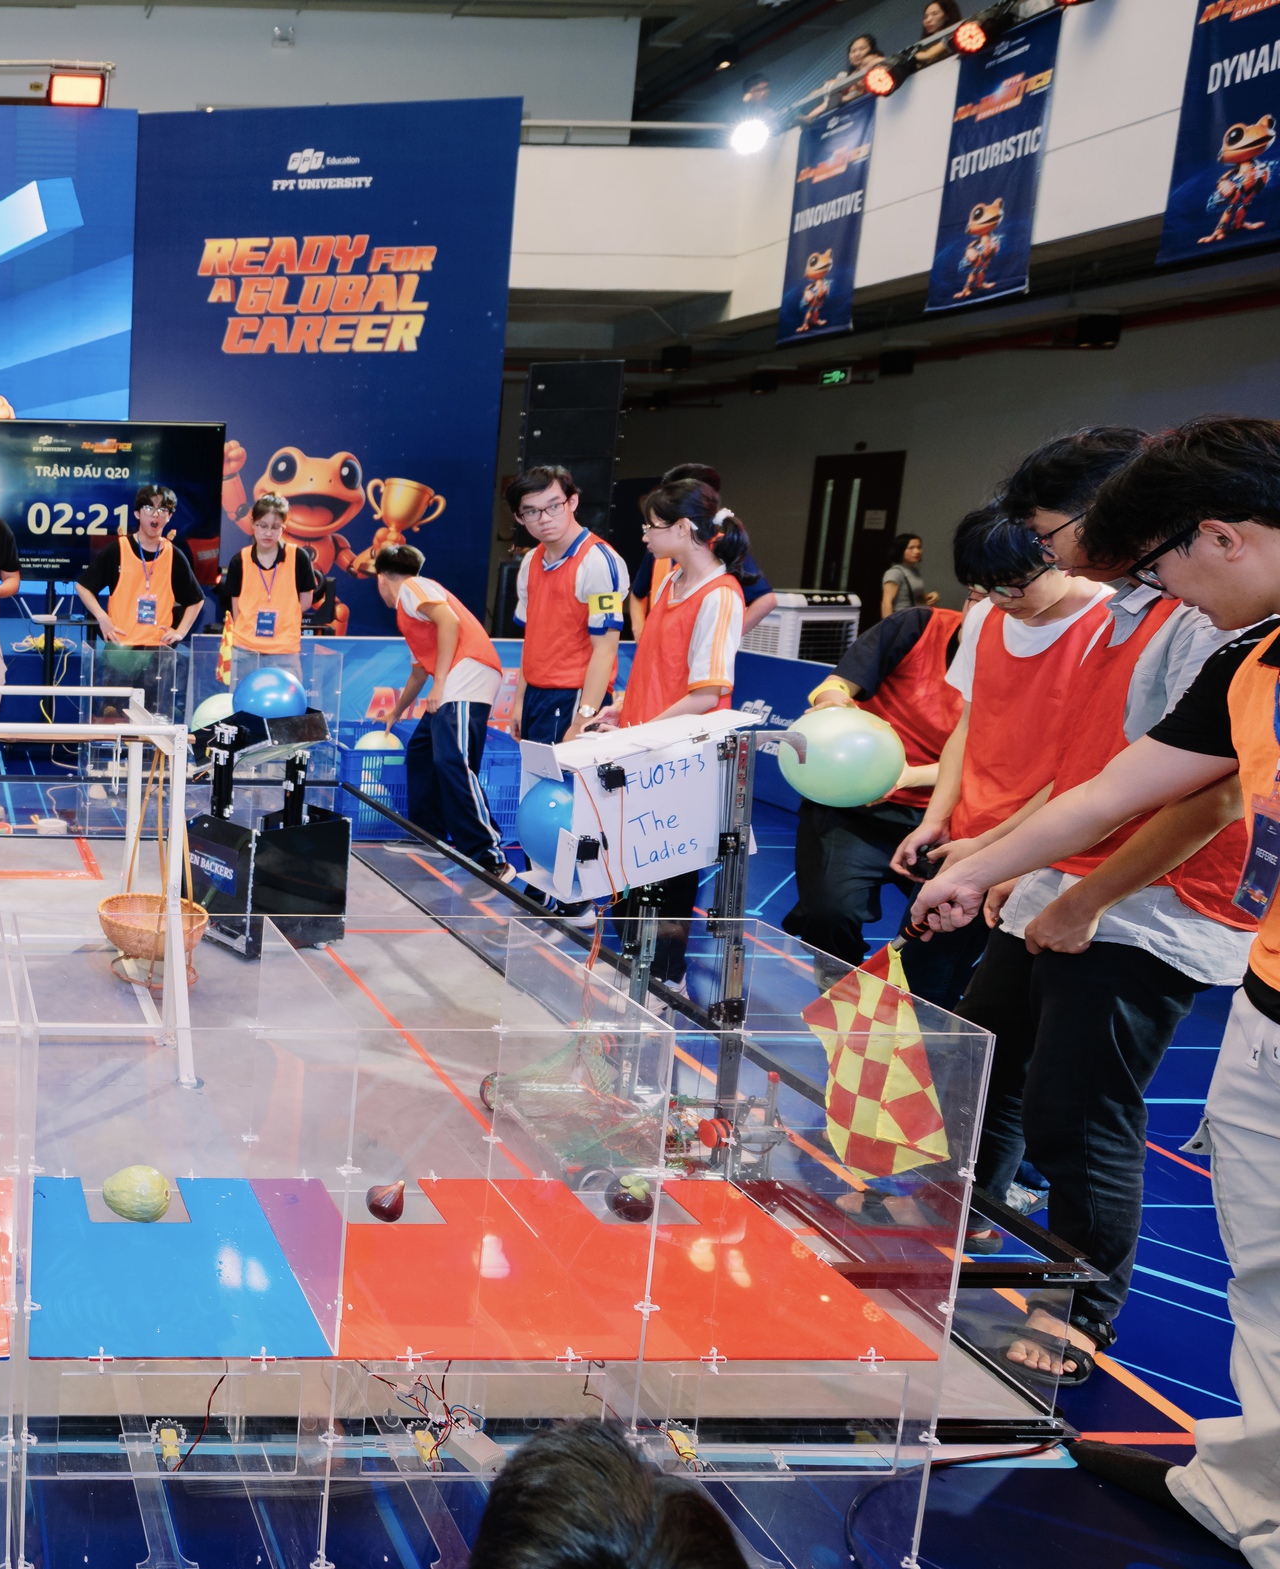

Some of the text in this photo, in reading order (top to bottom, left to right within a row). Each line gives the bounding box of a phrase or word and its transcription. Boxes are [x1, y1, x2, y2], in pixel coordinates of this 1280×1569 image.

[286, 148, 361, 174] FPT Education
[949, 126, 1041, 182] FUTURISTIC
[272, 176, 374, 192] FPT UNIVERSITY
[793, 189, 864, 233] INNOVATIVE
[197, 235, 437, 276] READY FOR
[207, 274, 429, 315] A GLOBAL
[221, 314, 425, 354] CAREER
[35, 463, 130, 480] TRẬN ĐẤU Q20
[27, 502, 129, 536] 02:21
[598, 595, 614, 611] C
[628, 810, 680, 836] The
[632, 837, 699, 868] Ladies
